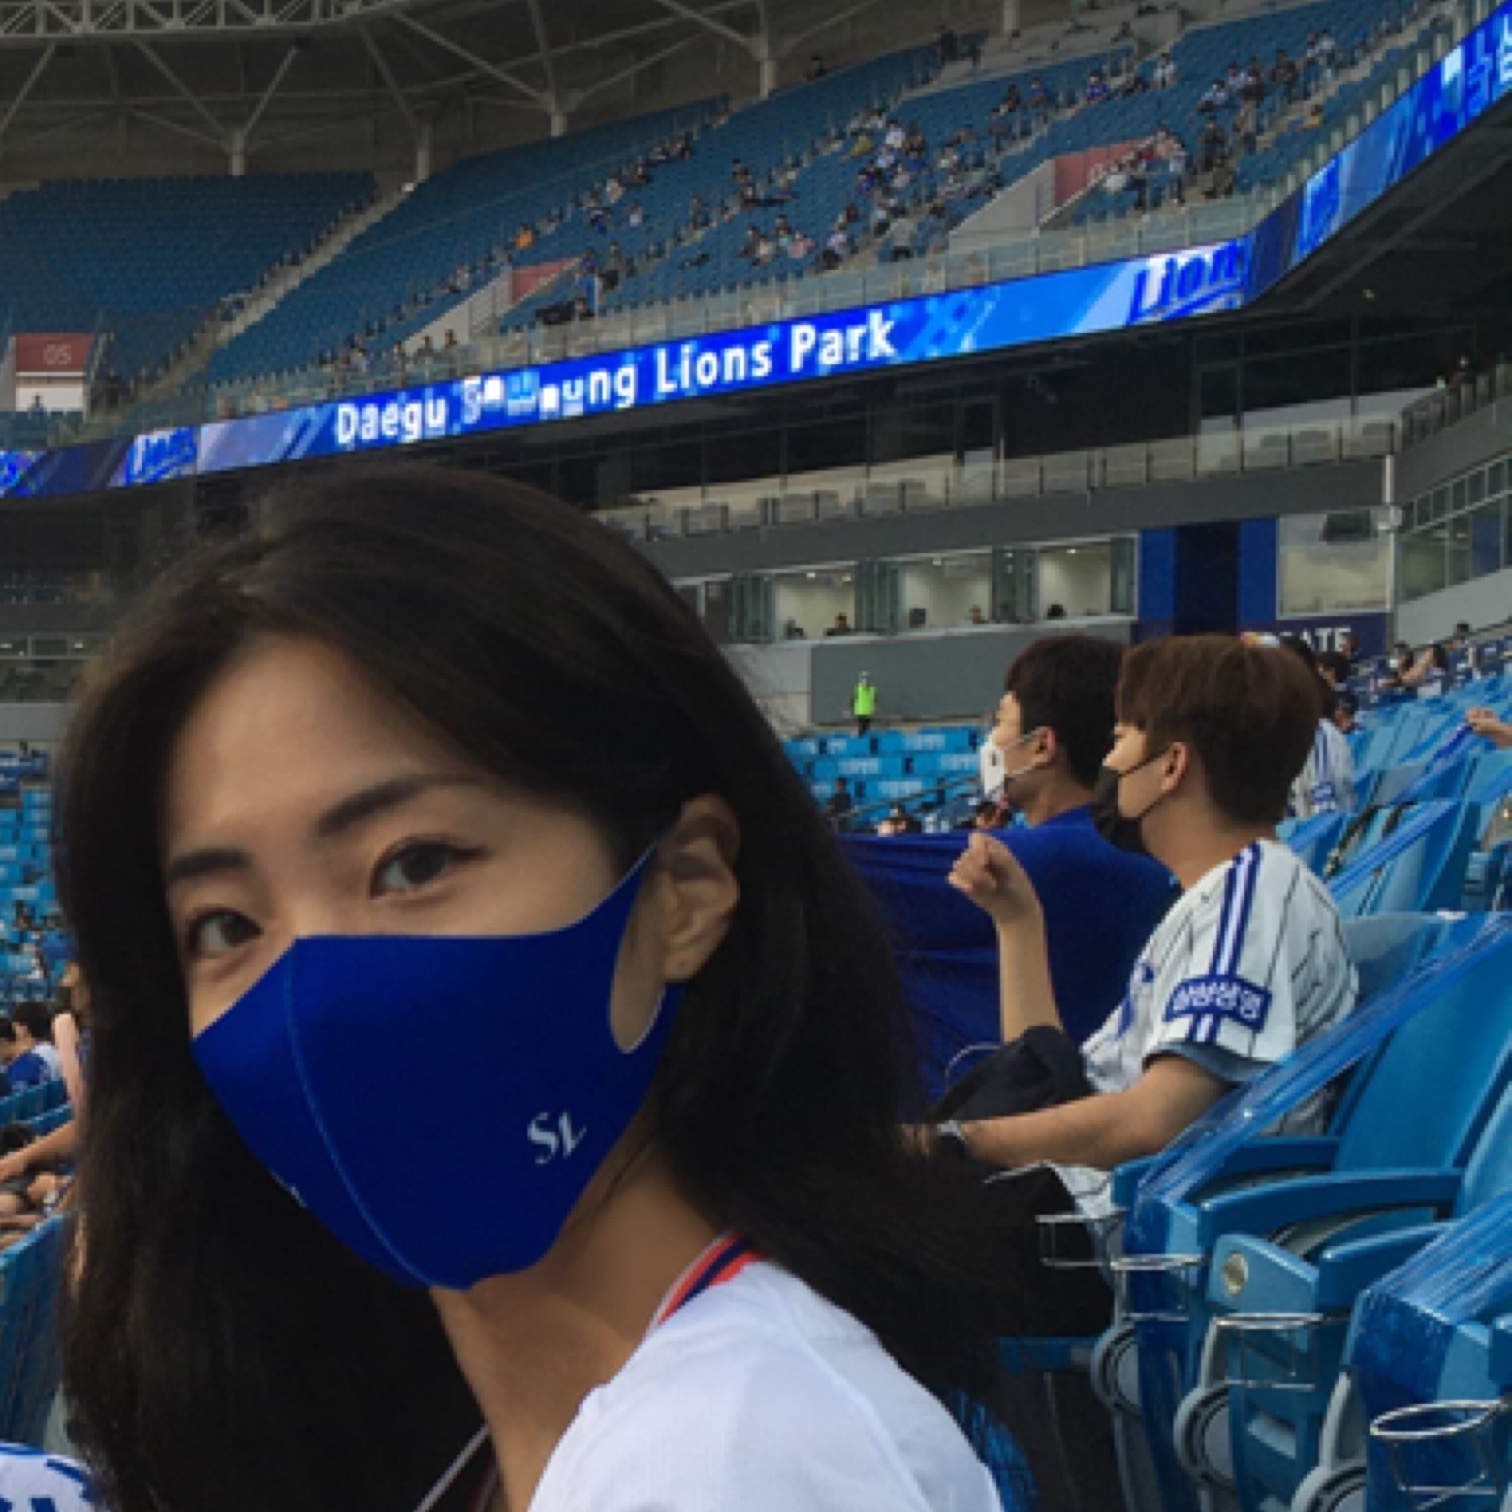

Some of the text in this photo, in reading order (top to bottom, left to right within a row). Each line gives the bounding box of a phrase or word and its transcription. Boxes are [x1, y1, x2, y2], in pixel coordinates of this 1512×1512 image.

[337, 308, 899, 445] Daegu Sung Lions Park
